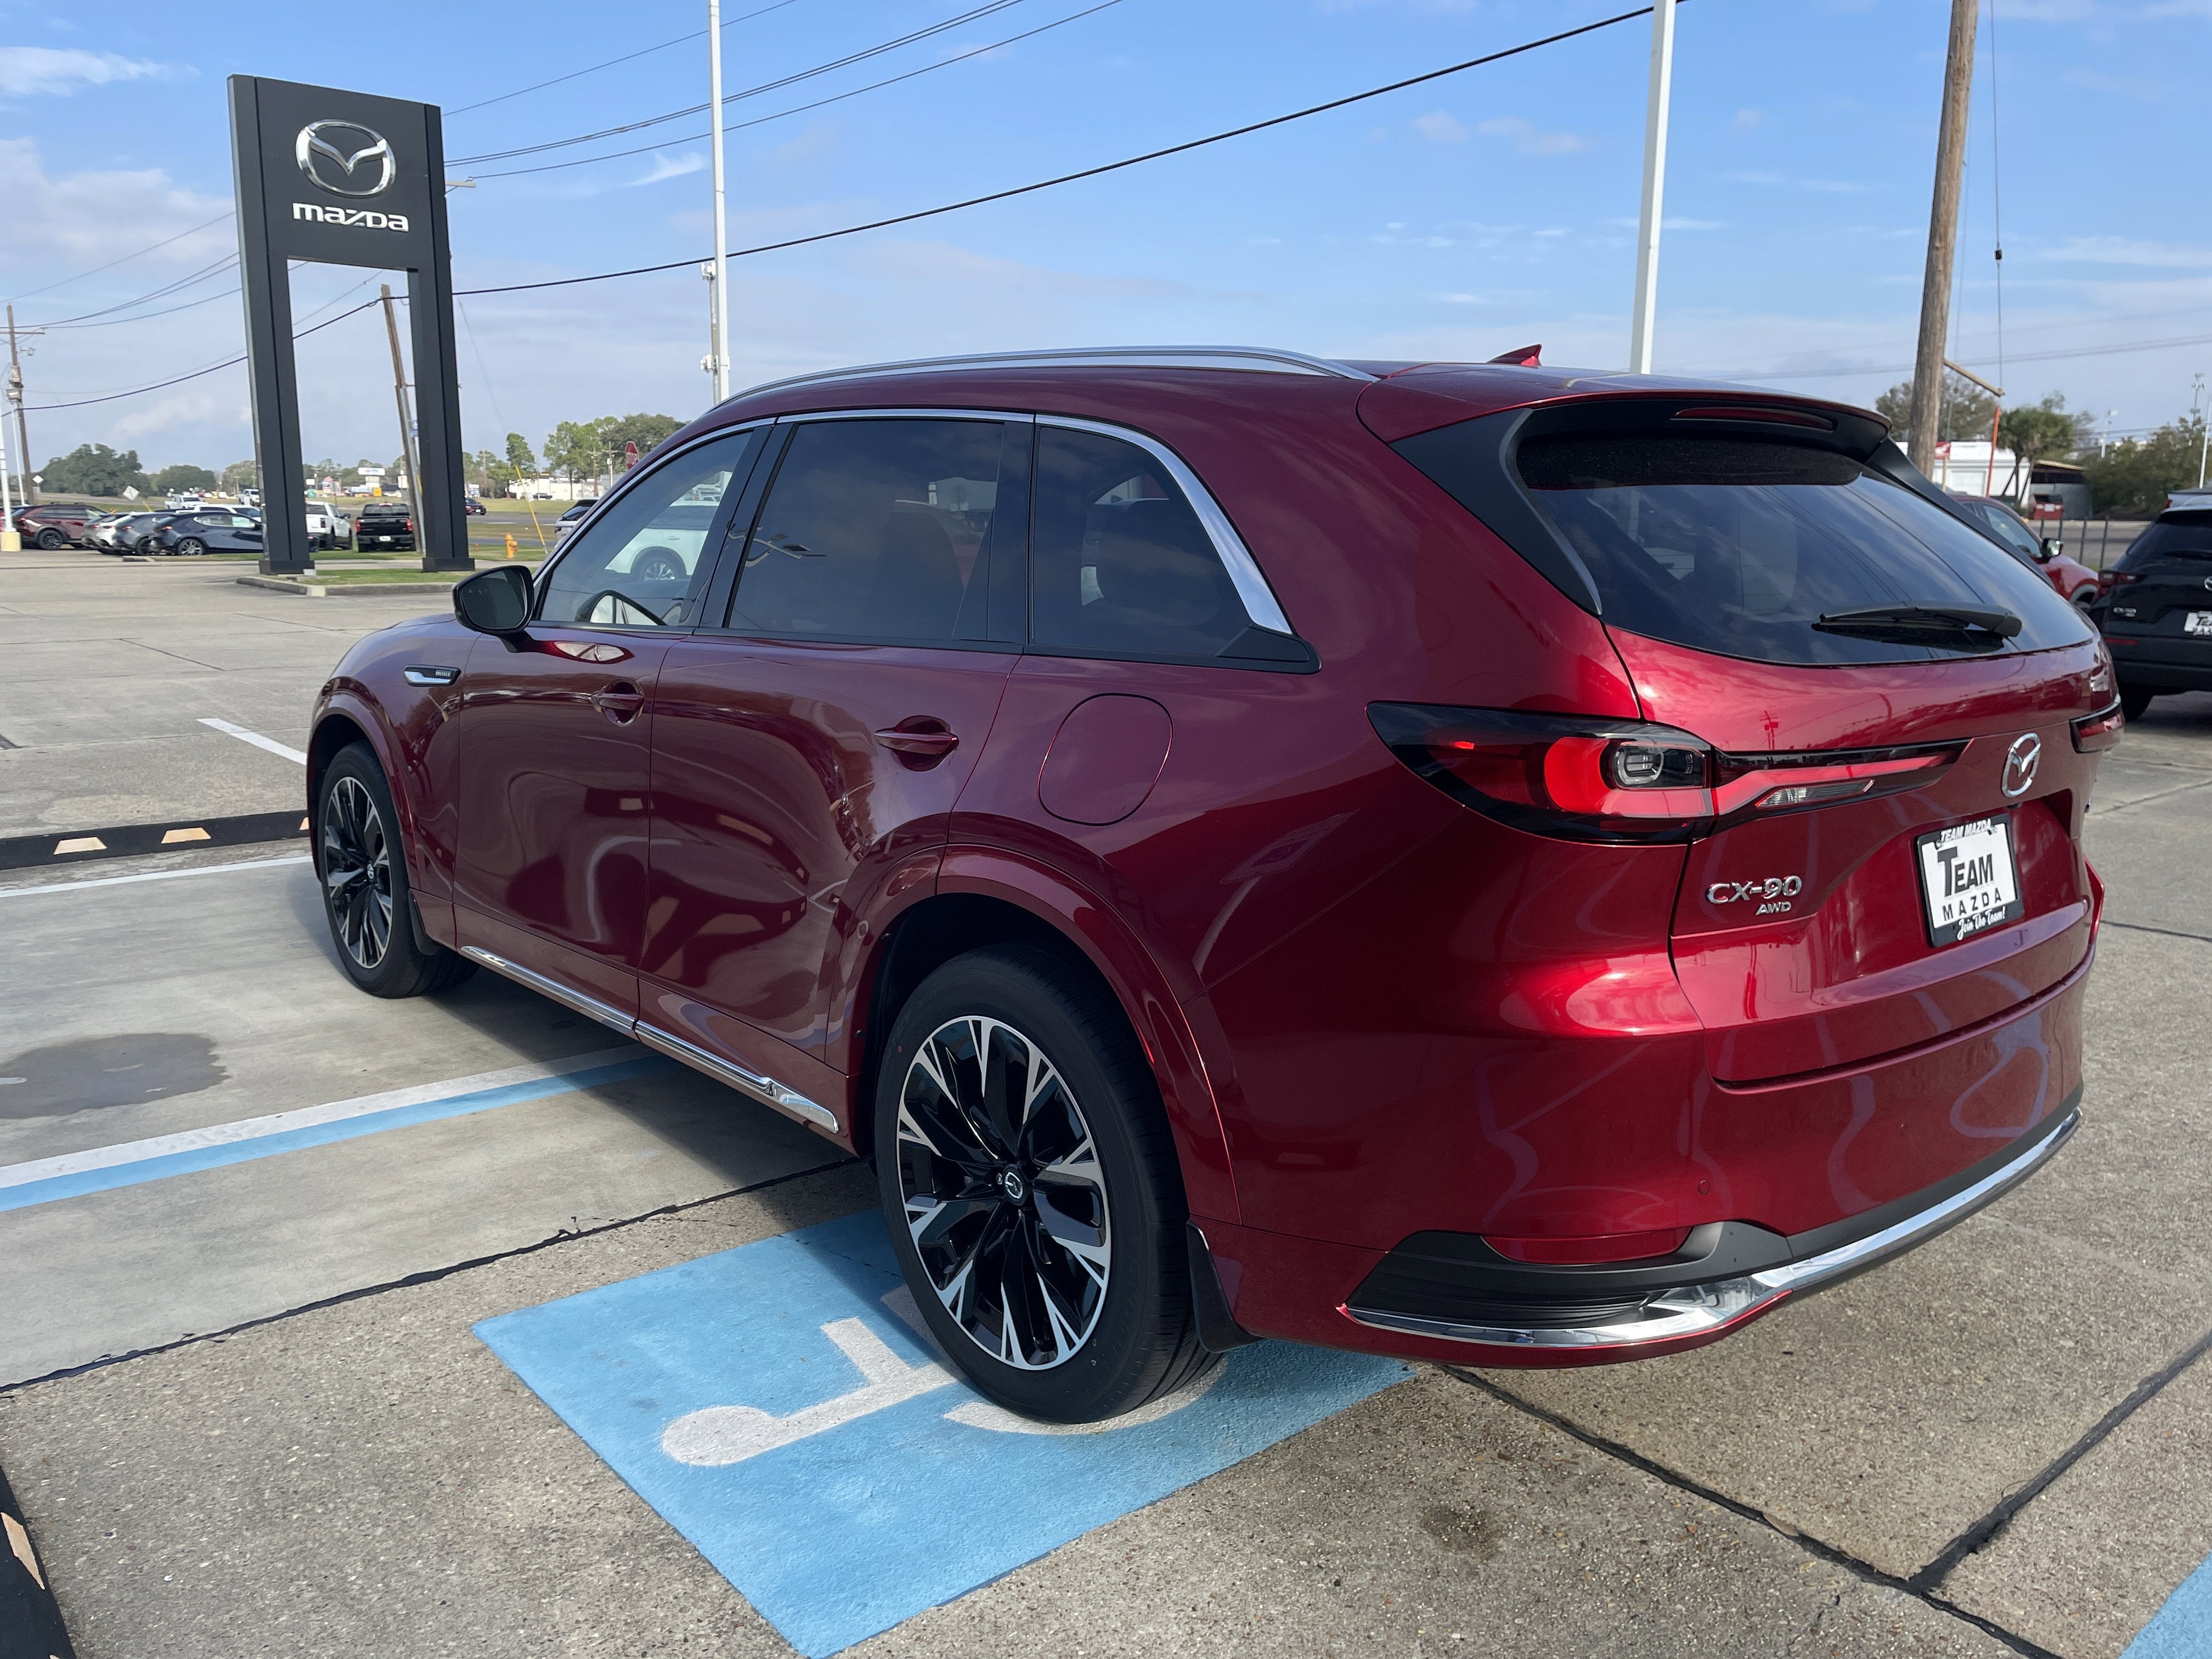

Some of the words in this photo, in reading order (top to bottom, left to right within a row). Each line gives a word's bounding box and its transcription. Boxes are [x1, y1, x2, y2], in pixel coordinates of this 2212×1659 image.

[626, 452, 638, 465] STOP
[1940, 826, 1965, 842] TEAM
[1964, 818, 1991, 837] MAZDA
[1937, 846, 1994, 898] TEAM
[1706, 874, 1803, 905] CX-90
[1755, 901, 1792, 916] AWD
[1942, 888, 2002, 922] MAZDA
[1957, 918, 1973, 940] Join
[1972, 913, 1987, 929] The
